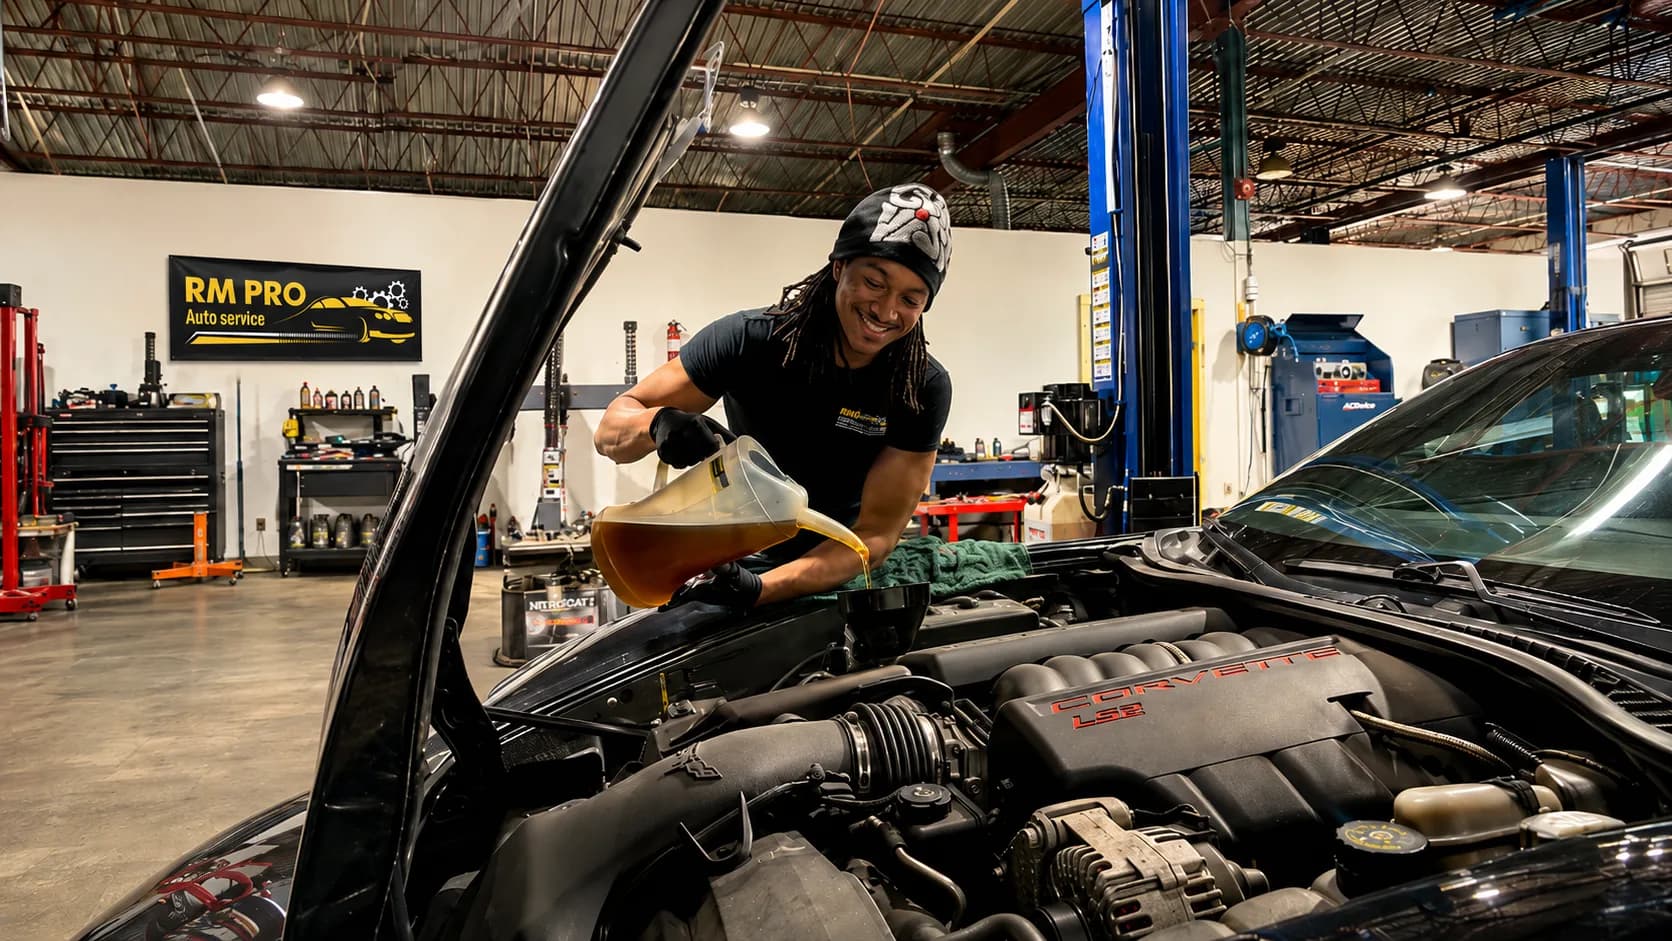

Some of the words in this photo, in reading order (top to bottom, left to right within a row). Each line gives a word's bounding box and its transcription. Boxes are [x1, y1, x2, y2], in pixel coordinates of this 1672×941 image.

[185, 276, 237, 305] RM
[245, 279, 307, 307] PRO
[185, 308, 217, 325] Auto
[220, 310, 265, 326] service
[1050, 646, 1341, 714] CORVETTE
[1072, 702, 1146, 730] LS2
